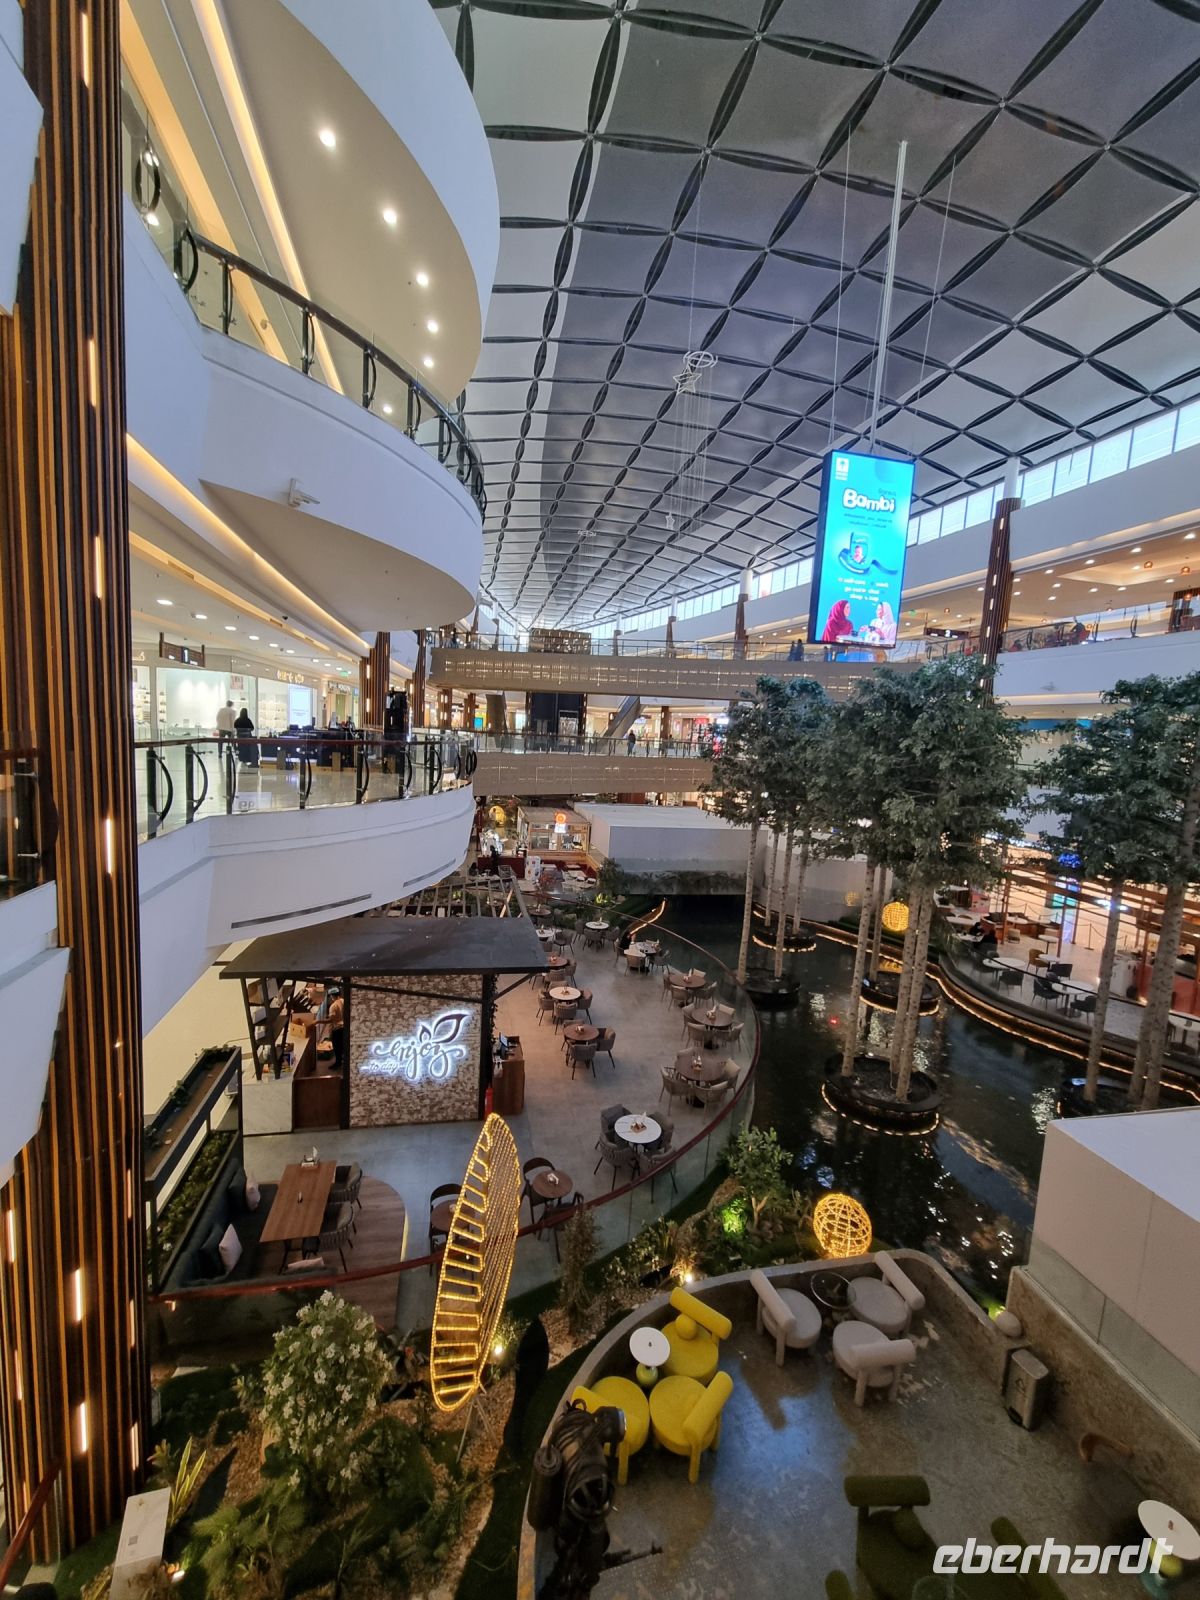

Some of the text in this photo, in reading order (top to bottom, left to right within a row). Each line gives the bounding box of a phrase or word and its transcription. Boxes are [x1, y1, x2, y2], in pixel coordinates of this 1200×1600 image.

[843, 487, 896, 513] Bambi
[944, 629, 951, 638] 2
[183, 649, 189, 663] 1
[373, 1039, 465, 1080] enjoy
